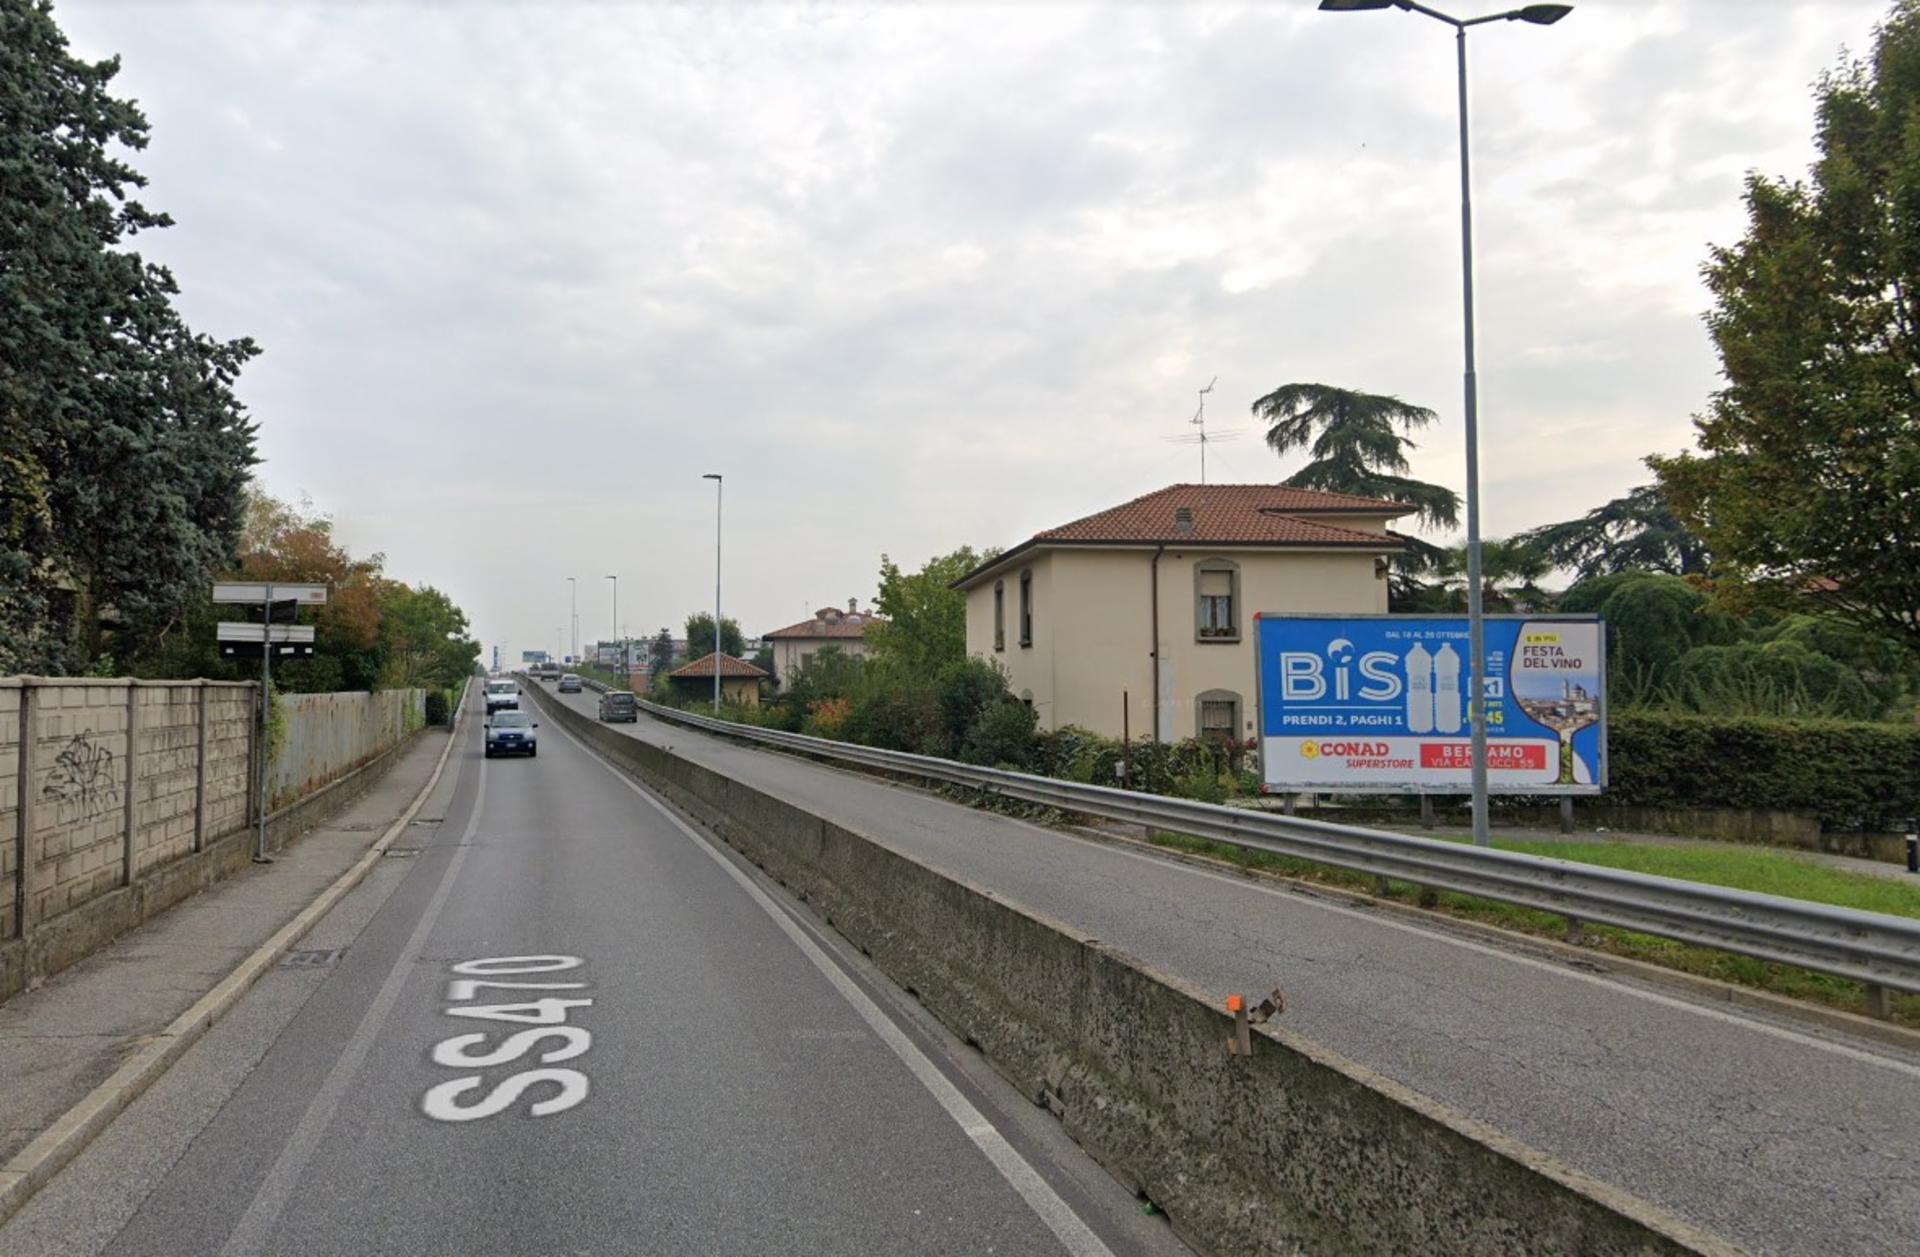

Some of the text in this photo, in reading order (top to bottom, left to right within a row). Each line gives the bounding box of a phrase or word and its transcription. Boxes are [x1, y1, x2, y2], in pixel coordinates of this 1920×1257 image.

[1523, 646, 1564, 657] FESTA
[1523, 657, 1582, 669] DEL VINO
[1282, 715, 1403, 727] PRENDI 2, PAGHI 1
[1320, 742, 1390, 757] CONAD
[1443, 745, 1524, 758] BERAMO
[1345, 758, 1415, 769] SUPERSTORE
[1431, 758, 1451, 768] VIA
[423, 955, 593, 1121] SS470
